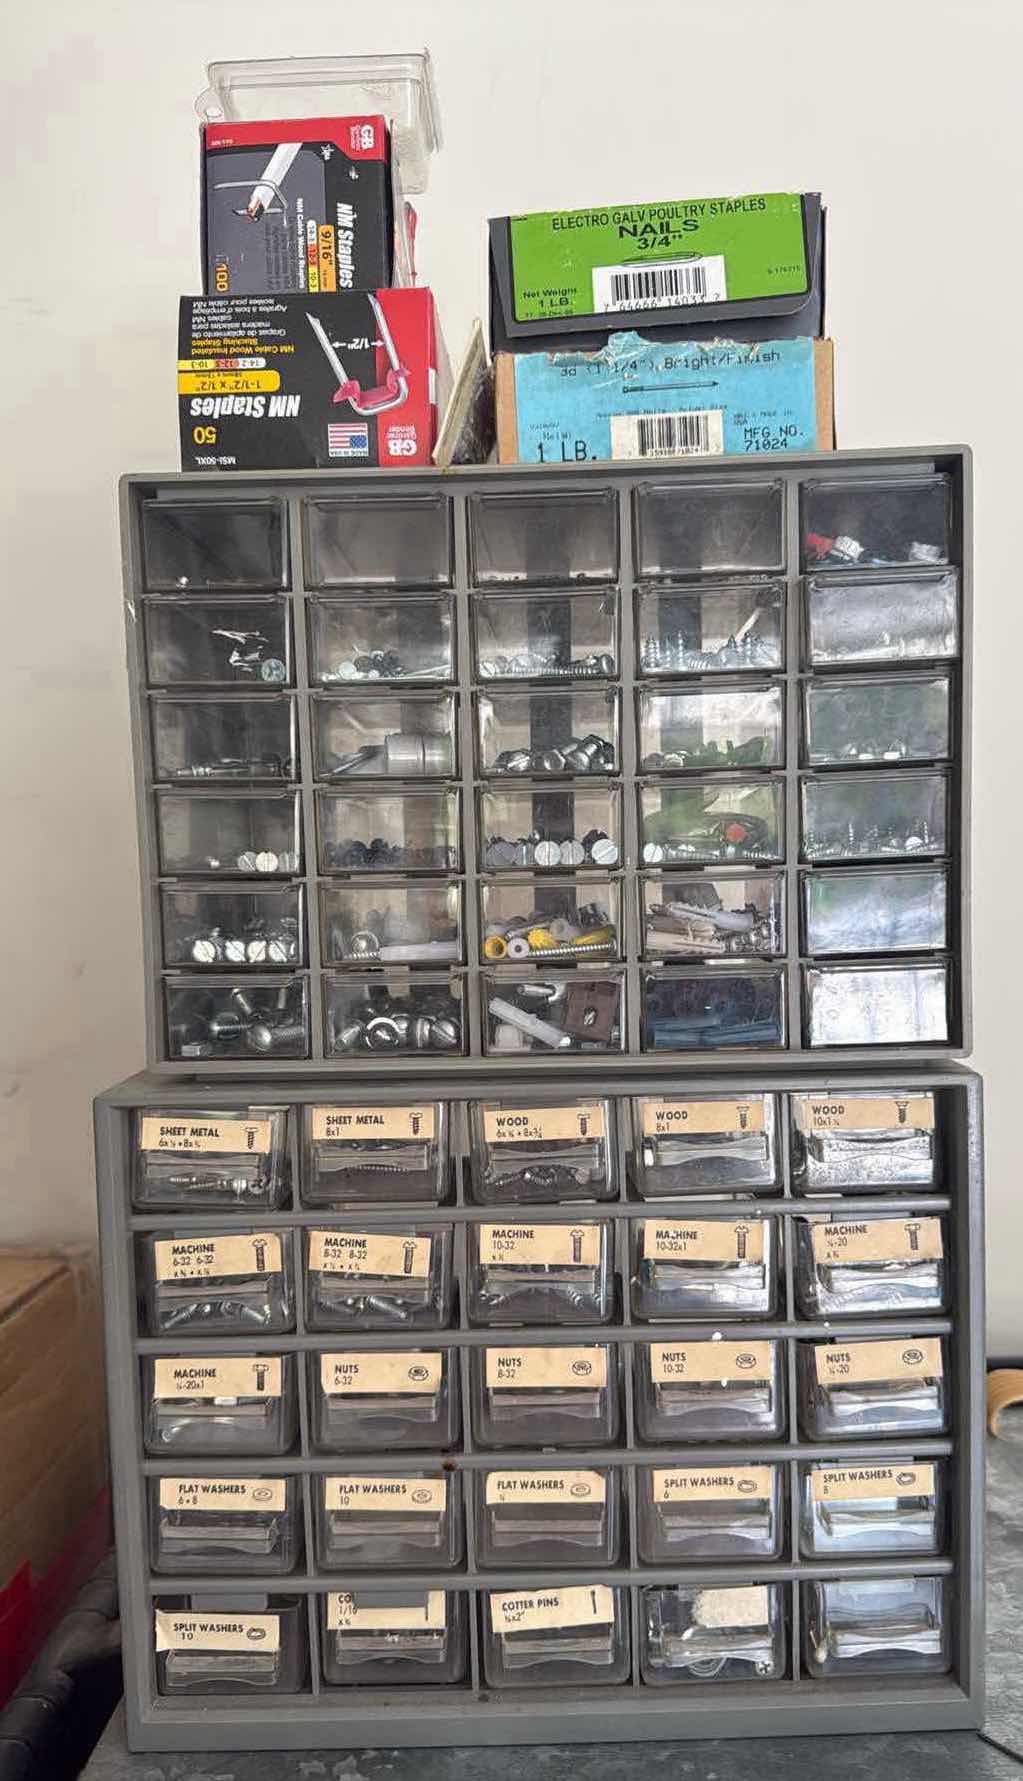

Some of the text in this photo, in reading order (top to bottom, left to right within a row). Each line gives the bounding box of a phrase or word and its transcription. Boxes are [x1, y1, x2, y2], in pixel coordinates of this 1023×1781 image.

[552, 198, 766, 231] ELECTRO GALV POULTRY STAPLES
[618, 218, 700, 239] NAILS
[321, 231, 333, 265] 9/16"
[337, 203, 355, 288] NM Staples
[216, 263, 228, 291] 100
[523, 287, 577, 299] Net Weight
[190, 394, 301, 419] NM Staples
[193, 426, 217, 444] 50
[779, 425, 804, 438] NO.
[388, 439, 417, 456] GB
[537, 440, 598, 464] 1 LB.
[744, 440, 788, 452] 71024
[655, 1110, 688, 1121] WOOD
[812, 1104, 845, 1115] WOOD
[325, 1114, 385, 1126] SHEET METAL
[496, 1116, 529, 1127] WOOD
[159, 1126, 220, 1138] SHEET METAL
[492, 1229, 535, 1239] MACHINE
[824, 1225, 869, 1236] MACHINE
[172, 1243, 216, 1255] MACHINE
[324, 1237, 368, 1249] MACHINE
[493, 1240, 516, 1250] 10-32
[498, 1357, 522, 1367] NUTS
[662, 1352, 687, 1362] NUTS
[826, 1352, 851, 1364] NUTS
[174, 1368, 217, 1379] MACHINE
[335, 1364, 359, 1374] NUTS
[663, 1363, 685, 1374] 10-32
[823, 1469, 893, 1483] SPLIT WASHERS
[497, 1479, 565, 1490] FLAT WASHERS
[664, 1476, 734, 1489] SPLIT WASHERS
[179, 1484, 246, 1494] FLAT WASHERS
[339, 1484, 407, 1494] FLAT WASHERS
[340, 1496, 350, 1505] 10
[502, 1597, 559, 1611] COTTER PINS
[173, 1623, 244, 1633] SPLIT WASHERS
[181, 1632, 194, 1640] 10
